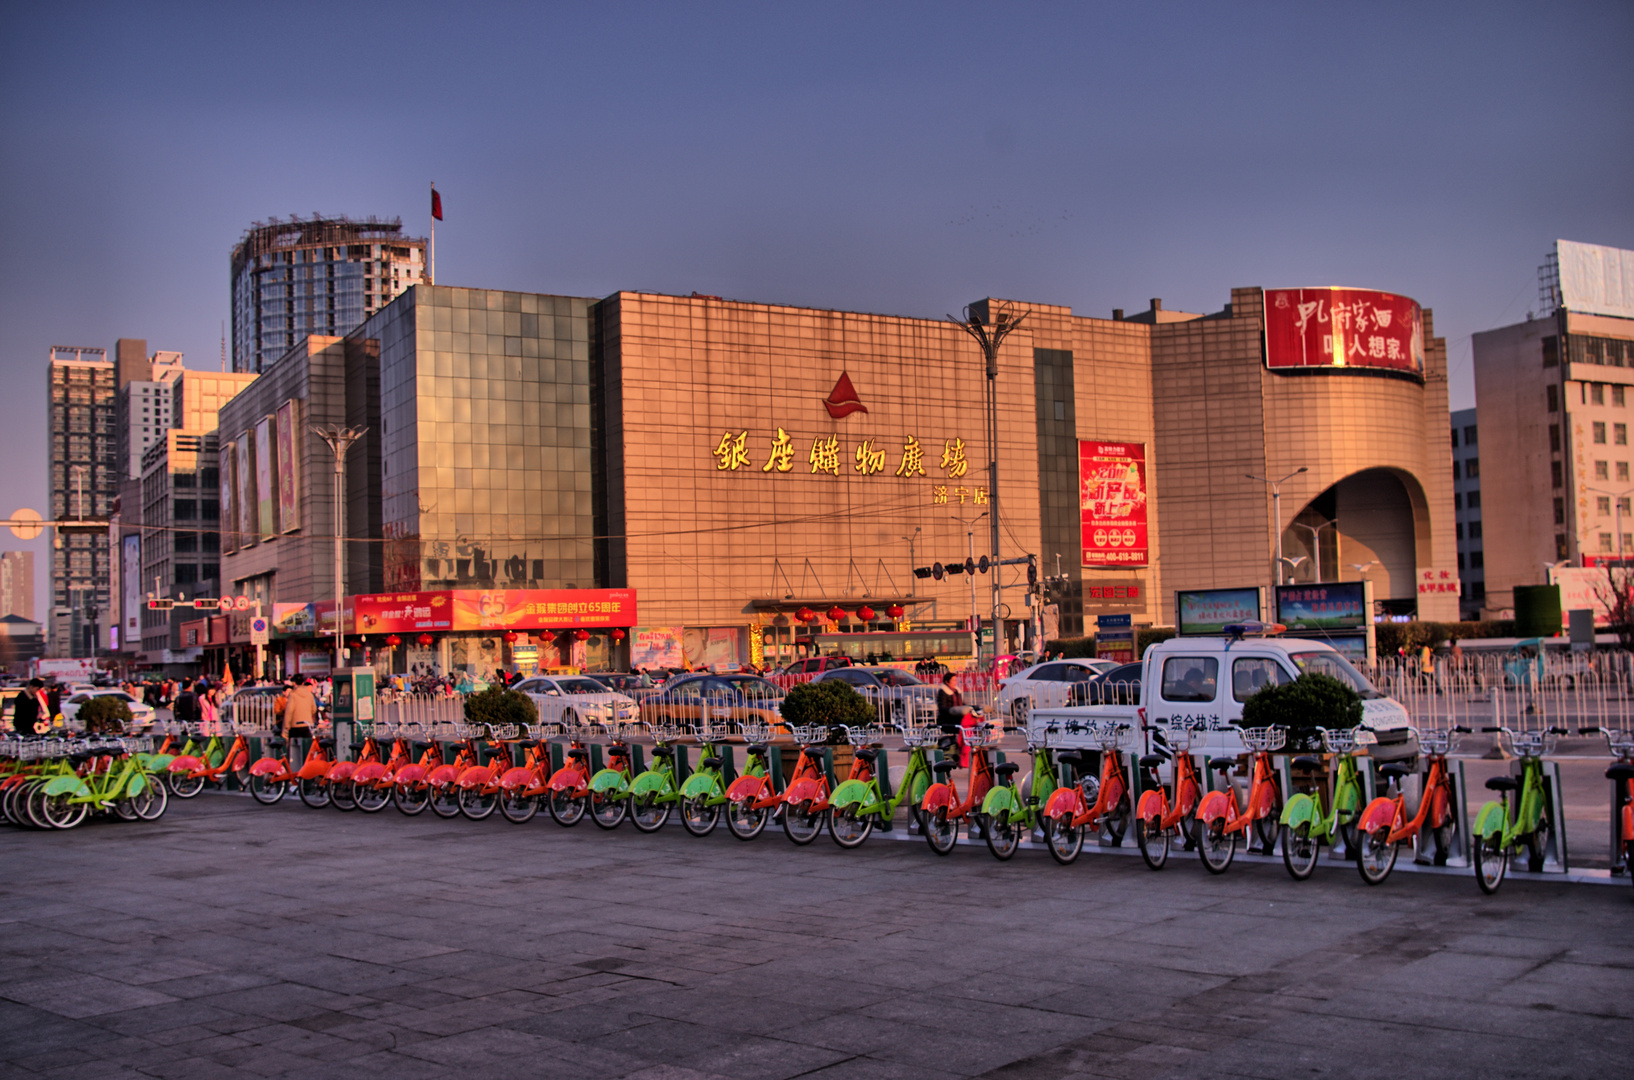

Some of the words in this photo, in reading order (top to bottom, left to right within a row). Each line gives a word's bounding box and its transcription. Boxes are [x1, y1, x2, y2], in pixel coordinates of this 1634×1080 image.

[1295, 299, 1393, 336] 孔府家酒
[933, 485, 989, 505] 济宁店
[1088, 481, 1139, 502] 新产品
[1094, 502, 1131, 517] 新上市
[1089, 586, 1140, 599] 宏图三胞
[478, 594, 506, 616] 65
[525, 602, 622, 615] 金猴集团创立65周年
[1171, 714, 1221, 732] 综合执法
